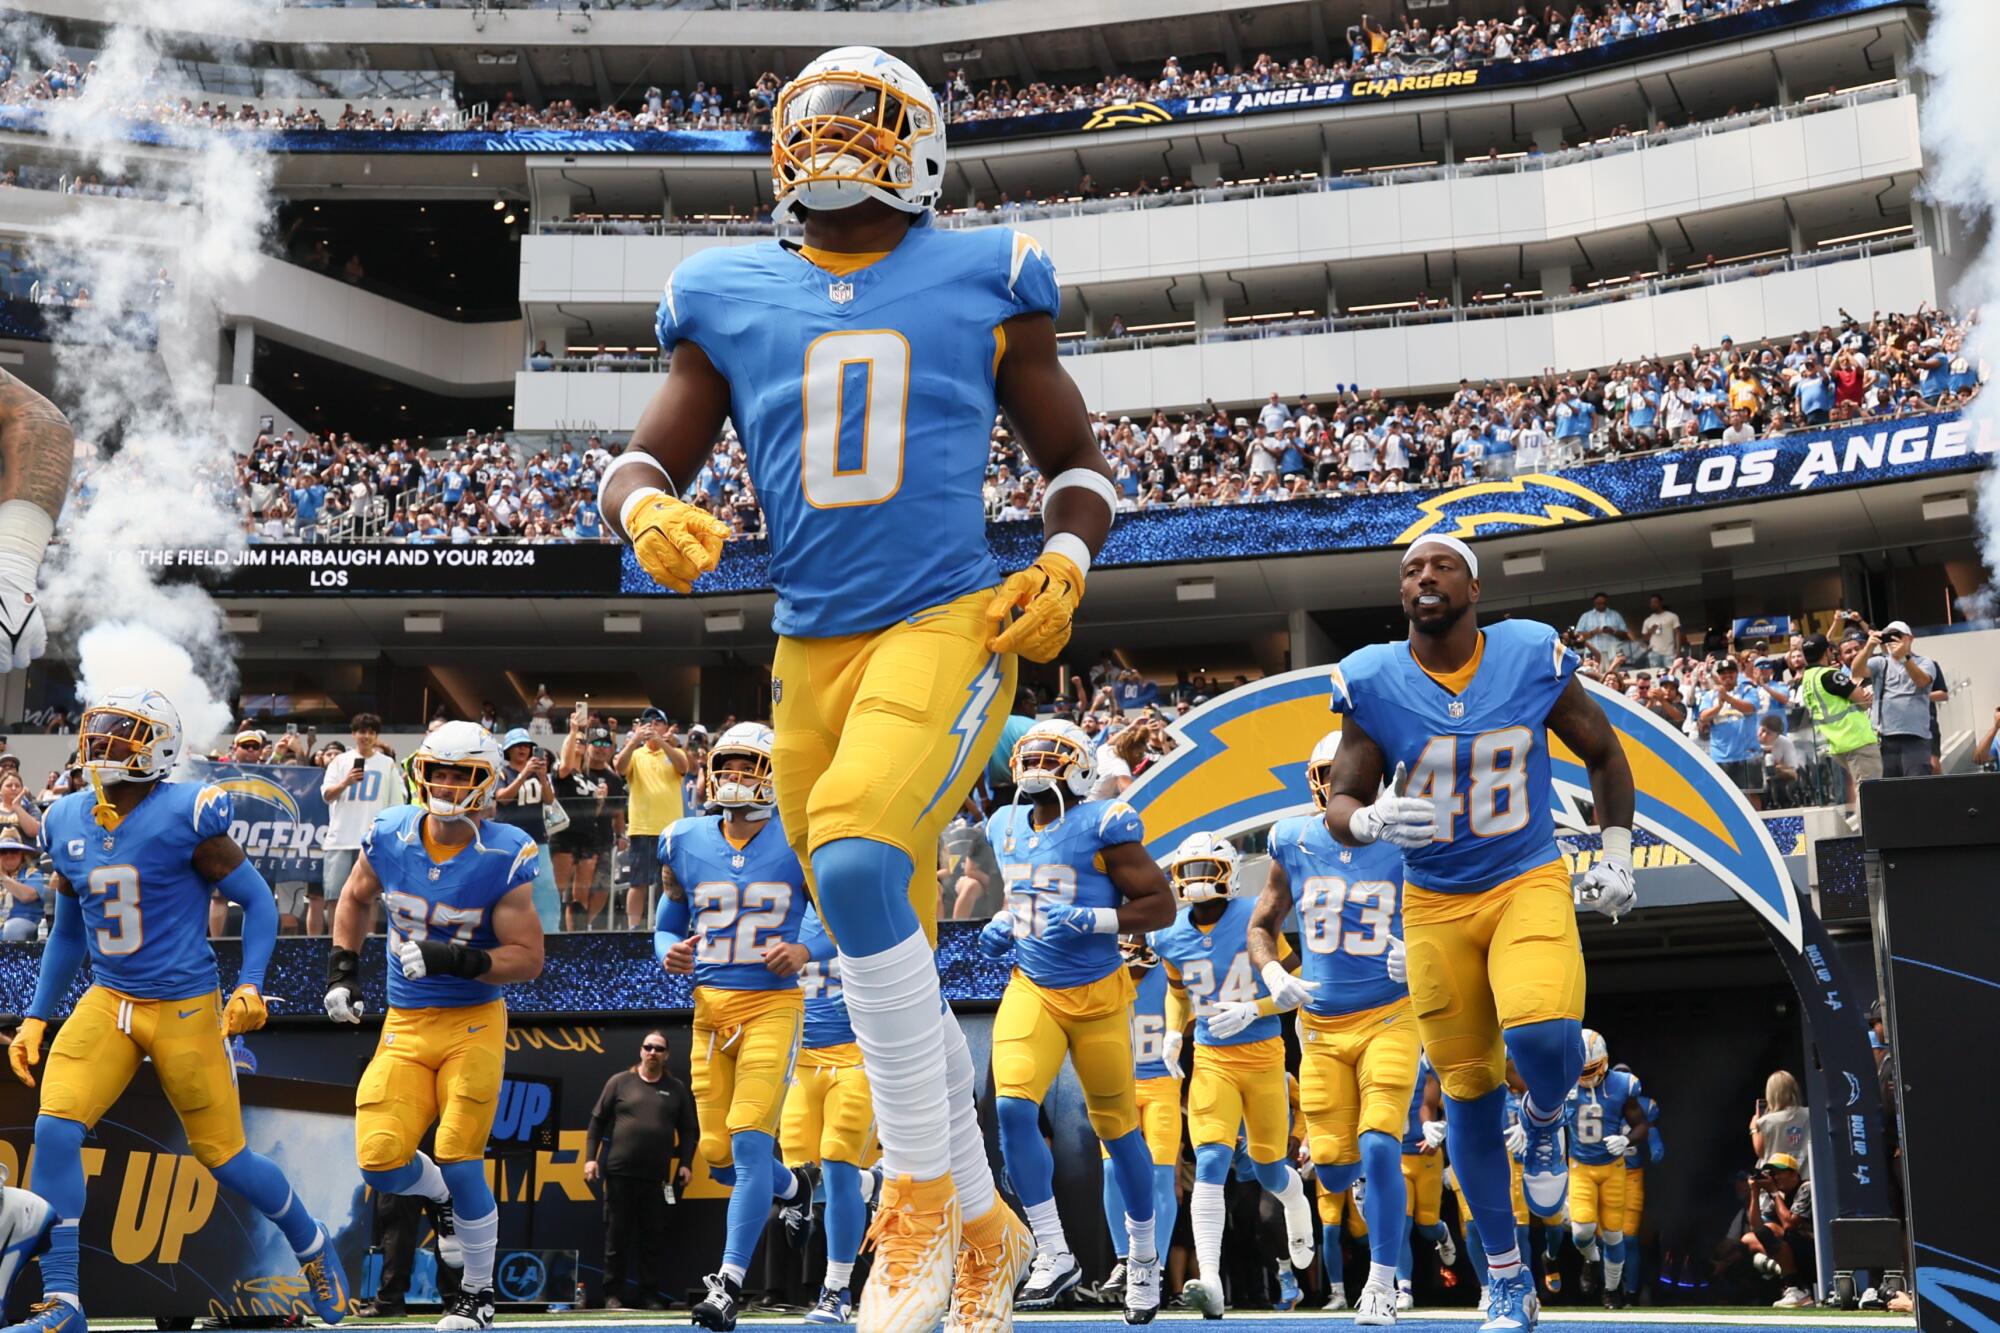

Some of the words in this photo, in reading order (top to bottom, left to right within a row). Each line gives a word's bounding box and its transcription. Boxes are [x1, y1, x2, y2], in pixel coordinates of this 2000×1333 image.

[1186, 95, 1231, 114] LOS
[1235, 84, 1345, 113] ANGELES
[1352, 69, 1479, 98] CHARGERS
[801, 328, 911, 509] 0
[1524, 435, 1539, 448] 10
[476, 470, 488, 484] 13
[1659, 449, 1778, 499] LOS
[138, 550, 174, 566] THE
[177, 550, 229, 566] FIELD
[233, 550, 267, 567] JIM
[271, 550, 382, 566] HARBAUGH
[385, 550, 428, 566] AND
[433, 550, 489, 566] YOUR
[492, 549, 536, 566] 2024
[310, 570, 349, 587] LOS
[517, 778, 543, 806] 10
[1404, 725, 1534, 843] 48
[67, 839, 86, 857] C
[227, 819, 328, 859] RGERS
[254, 859, 317, 871] GELES
[88, 864, 144, 956] 3
[1002, 863, 1077, 939] 52
[693, 881, 793, 964] 22
[1300, 875, 1397, 956] 83
[1805, 944, 1826, 969] BOLT
[1182, 951, 1259, 1017] 24
[1815, 966, 1832, 983] UP
[1824, 990, 1843, 1012] LA
[492, 1078, 553, 1143] UP
[1577, 1103, 1603, 1145] 6
[1850, 1114, 1866, 1139] BOLT
[1853, 1139, 1867, 1156] UP
[1852, 1164, 1871, 1185] LA
[111, 1151, 218, 1264] UP
[505, 1266, 540, 1291] LA
